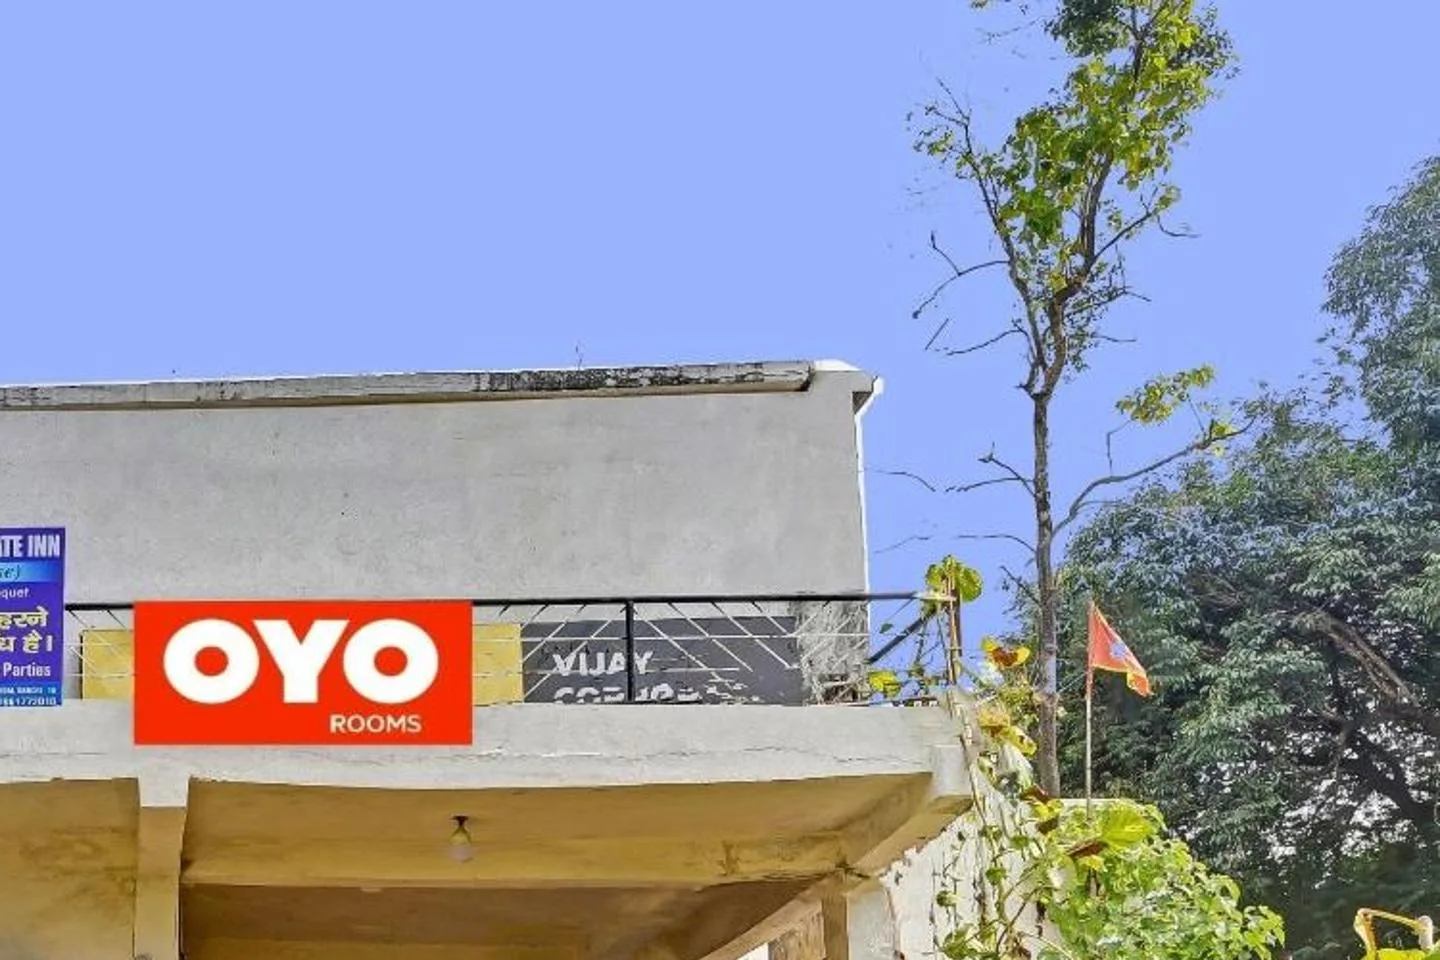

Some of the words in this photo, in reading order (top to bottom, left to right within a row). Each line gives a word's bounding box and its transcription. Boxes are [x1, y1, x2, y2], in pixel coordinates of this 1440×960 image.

[28, 535, 60, 558] INN
[3, 662, 51, 678] Parties
[163, 618, 439, 704] OYO
[552, 651, 653, 676] VIJAY
[329, 714, 422, 733] ROOMS
